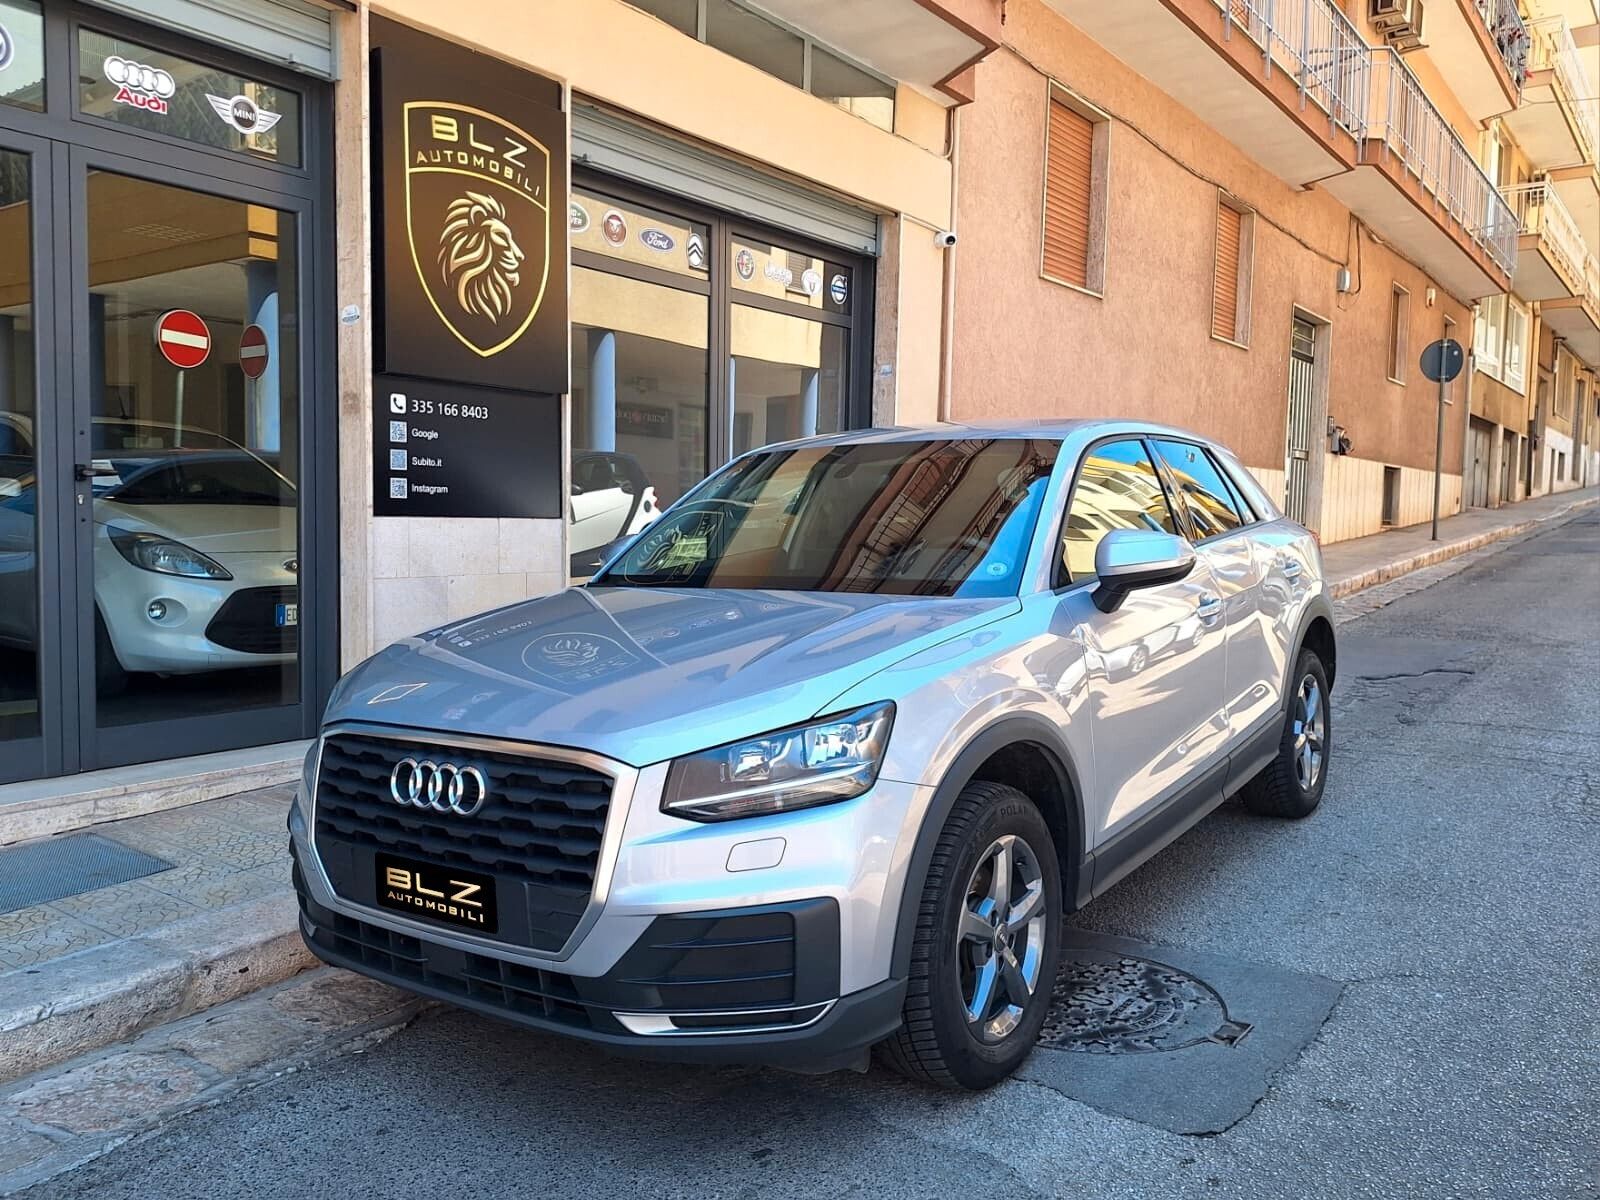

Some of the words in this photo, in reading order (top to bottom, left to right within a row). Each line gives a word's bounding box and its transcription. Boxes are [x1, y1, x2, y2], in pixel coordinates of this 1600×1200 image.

[232, 107, 257, 120] MINI
[430, 114, 528, 169] BLZ
[416, 149, 540, 197] AUTOMOBILI
[646, 231, 669, 250] Ford
[411, 399, 434, 414] 335
[437, 402, 458, 417] 166
[461, 405, 489, 419] 8403
[411, 428, 439, 441] Google
[411, 457, 442, 468] Subito.it
[411, 483, 448, 495] Instagram
[386, 866, 483, 908] BLZ
[387, 890, 484, 923] AUTOMOBILI
